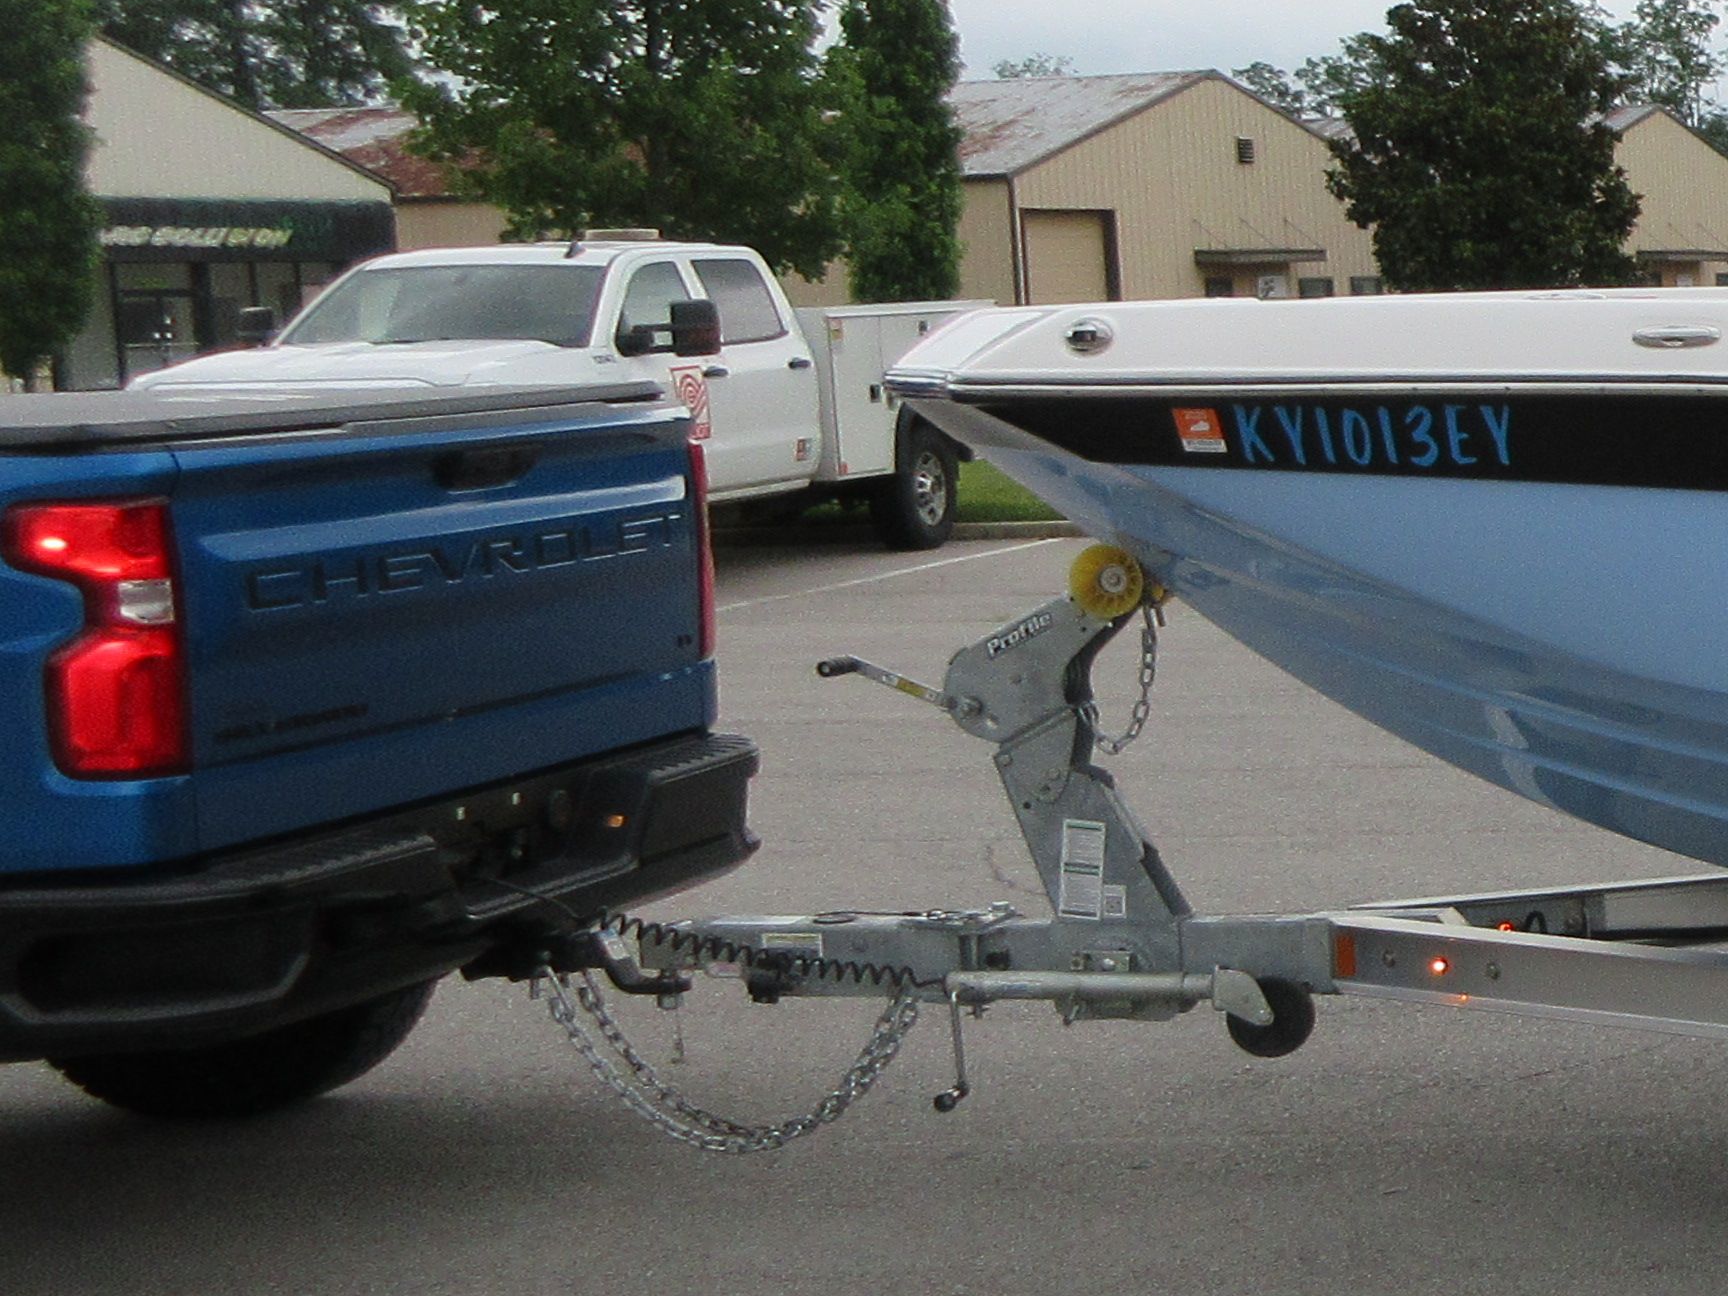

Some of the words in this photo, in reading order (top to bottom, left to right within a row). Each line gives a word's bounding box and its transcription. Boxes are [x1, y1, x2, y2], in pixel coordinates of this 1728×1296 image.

[1233, 404, 1511, 467] KY1013EY
[244, 514, 682, 614] CHEVROLET
[986, 611, 1053, 658] Profile
